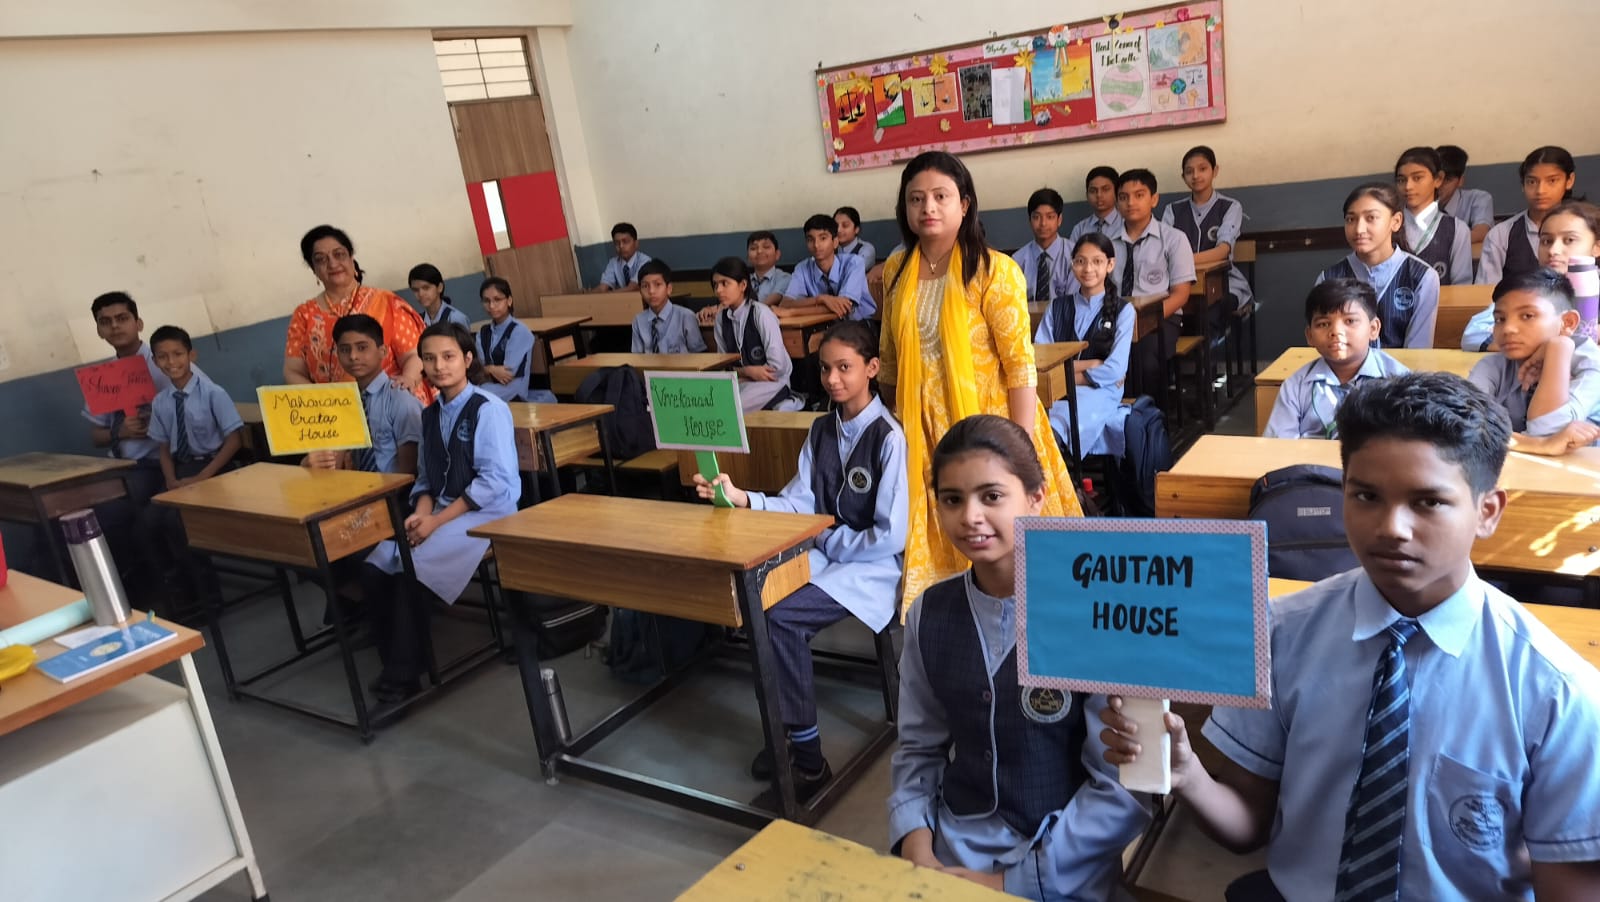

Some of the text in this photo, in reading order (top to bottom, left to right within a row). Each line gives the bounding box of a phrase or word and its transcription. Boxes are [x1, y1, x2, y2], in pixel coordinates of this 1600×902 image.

[273, 393, 351, 410] Maharana
[655, 385, 714, 408] Vivekanand
[289, 409, 338, 426] Pratap
[684, 415, 726, 440] House
[298, 428, 340, 441] House
[1072, 553, 1194, 588] GAUTAM
[1092, 602, 1180, 637] HOUSE
